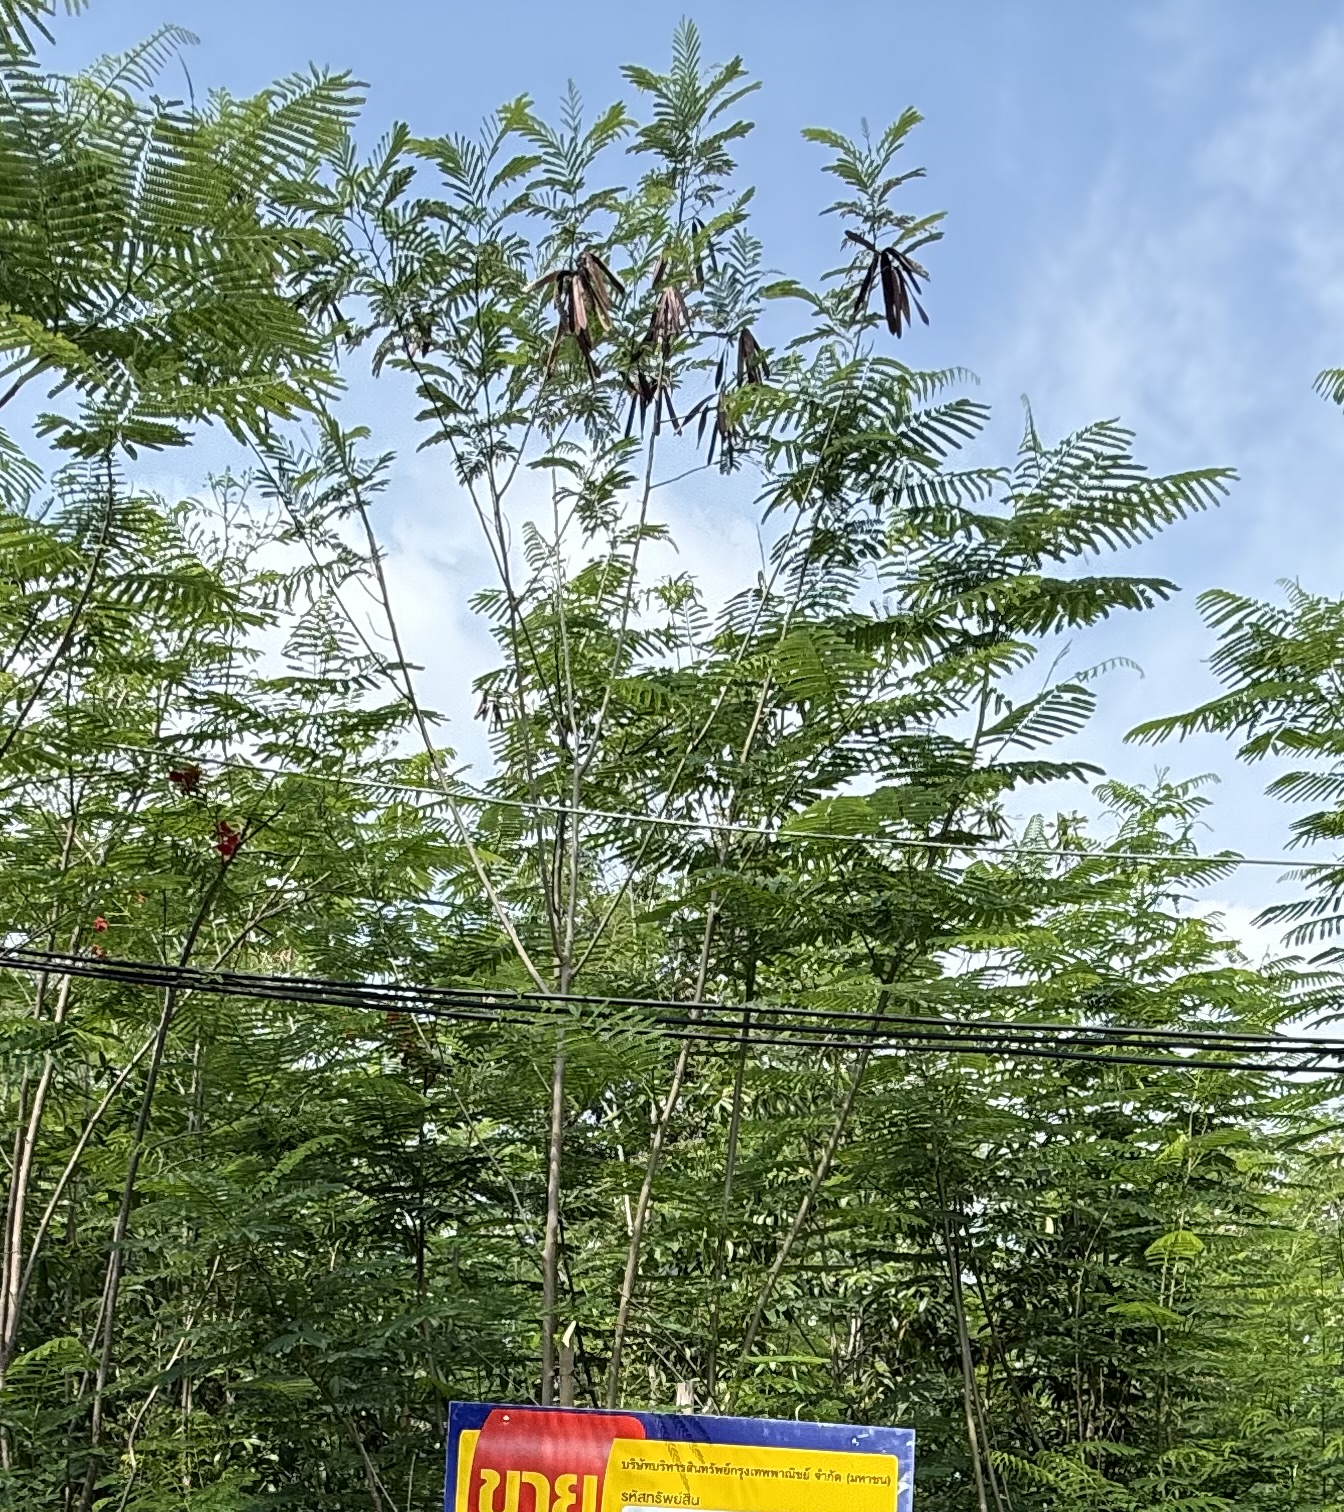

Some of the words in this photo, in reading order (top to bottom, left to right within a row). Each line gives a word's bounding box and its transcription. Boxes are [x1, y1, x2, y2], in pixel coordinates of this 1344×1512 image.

[814, 1468, 842, 1483] จำกัด
[846, 1473, 892, 1487] (มหาชน)
[620, 1489, 700, 1506] รหัสทรัพย์สิน
